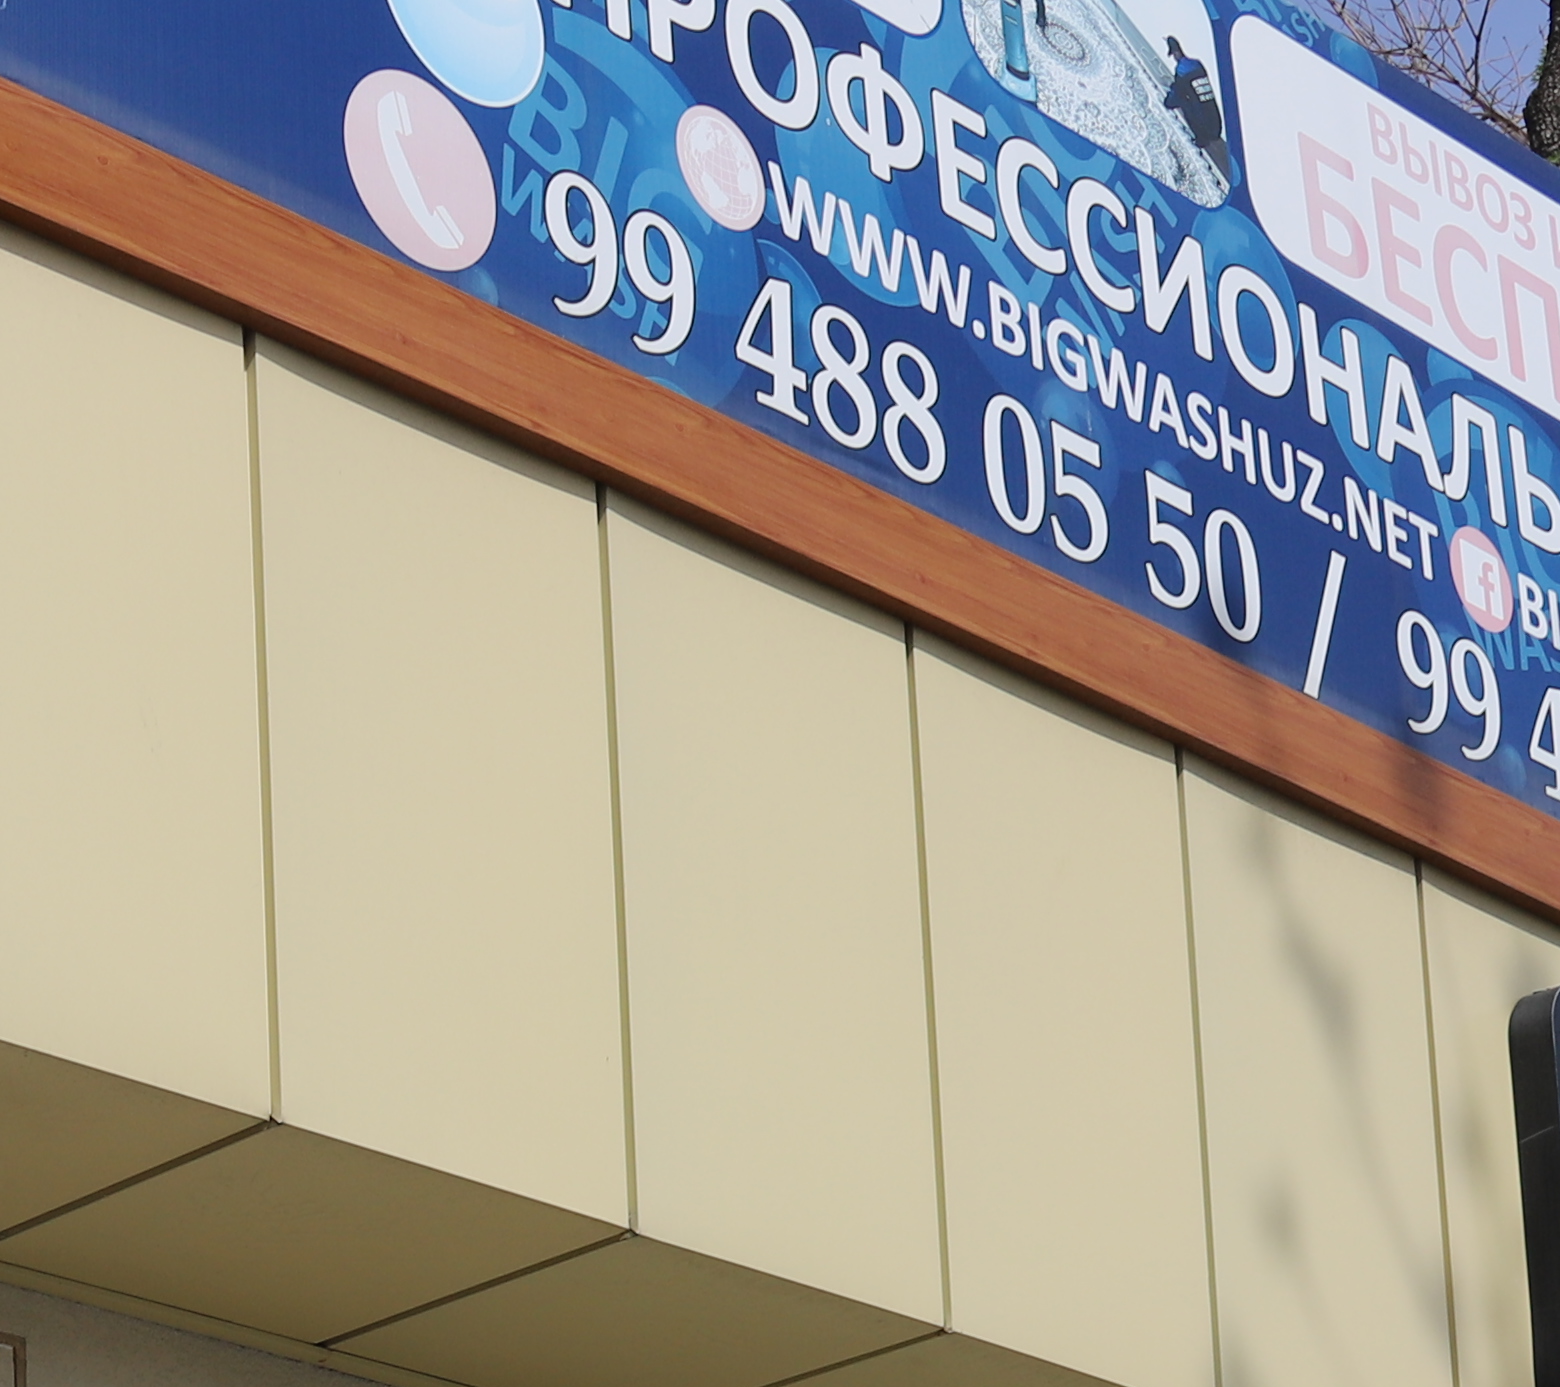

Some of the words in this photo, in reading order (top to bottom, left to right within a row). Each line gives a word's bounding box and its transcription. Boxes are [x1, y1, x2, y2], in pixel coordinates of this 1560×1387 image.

[767, 159, 1440, 581] WWW.BIGWASHUZ.NET
[1365, 100, 1537, 251] ВЫВОЗ
[544, 169, 698, 356] 99
[734, 276, 948, 486] 488
[983, 393, 1109, 564] 05
[1144, 468, 1262, 644] 50
[1395, 608, 1504, 762] 99
